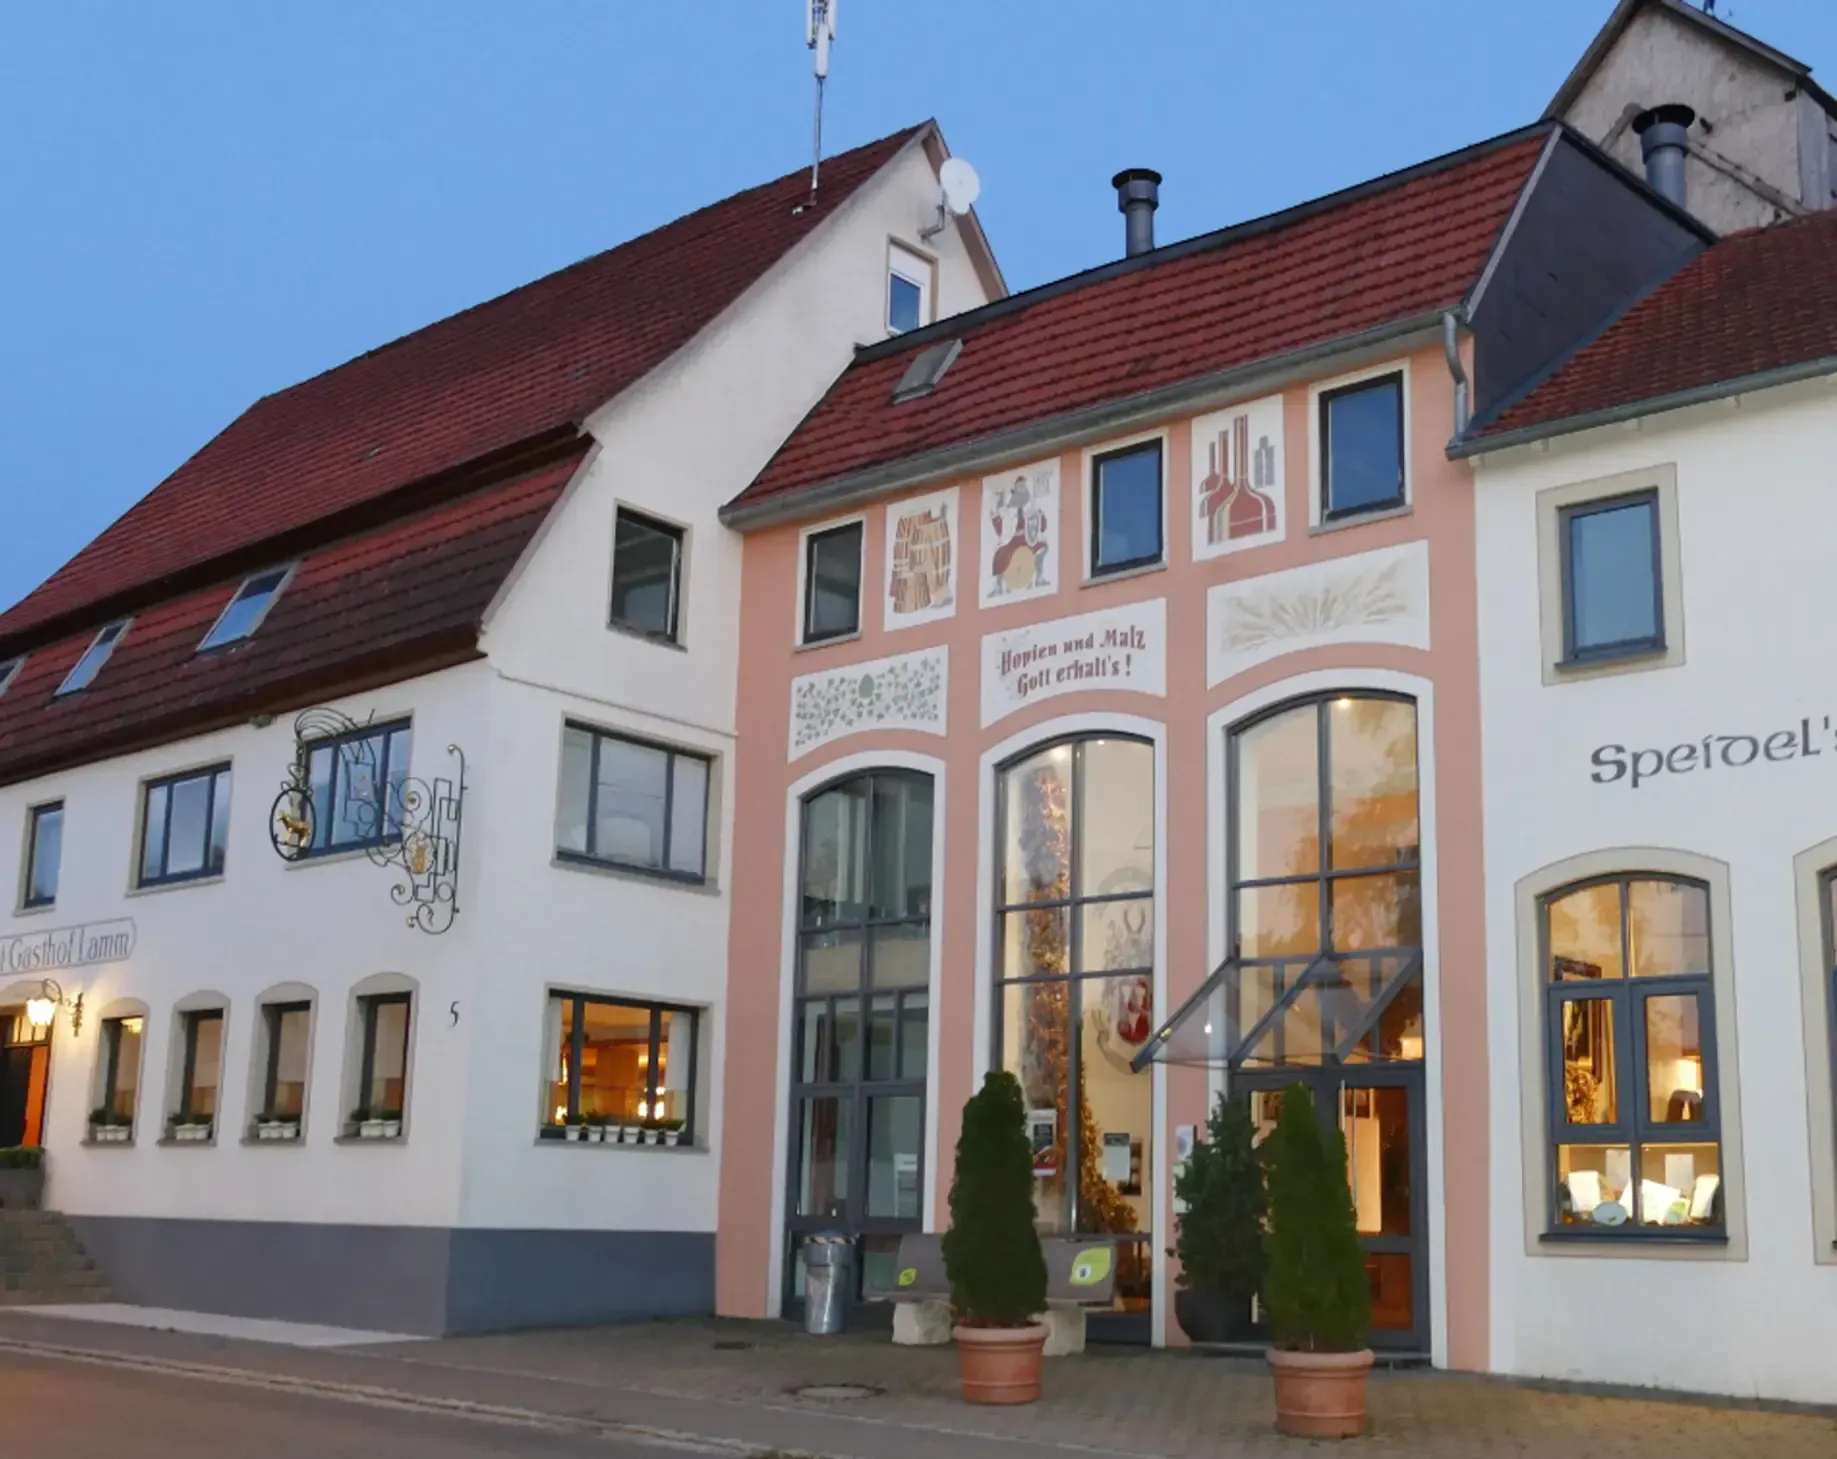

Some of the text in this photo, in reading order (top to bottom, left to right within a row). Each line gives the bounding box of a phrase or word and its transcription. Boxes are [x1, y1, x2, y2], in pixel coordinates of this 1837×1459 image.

[1063, 632, 1094, 654] und
[1099, 624, 1147, 650] Malz
[1016, 667, 1051, 698] Gott
[9, 928, 76, 971] Gasthof
[78, 927, 130, 962] Lamm
[445, 1000, 460, 1029] 5
